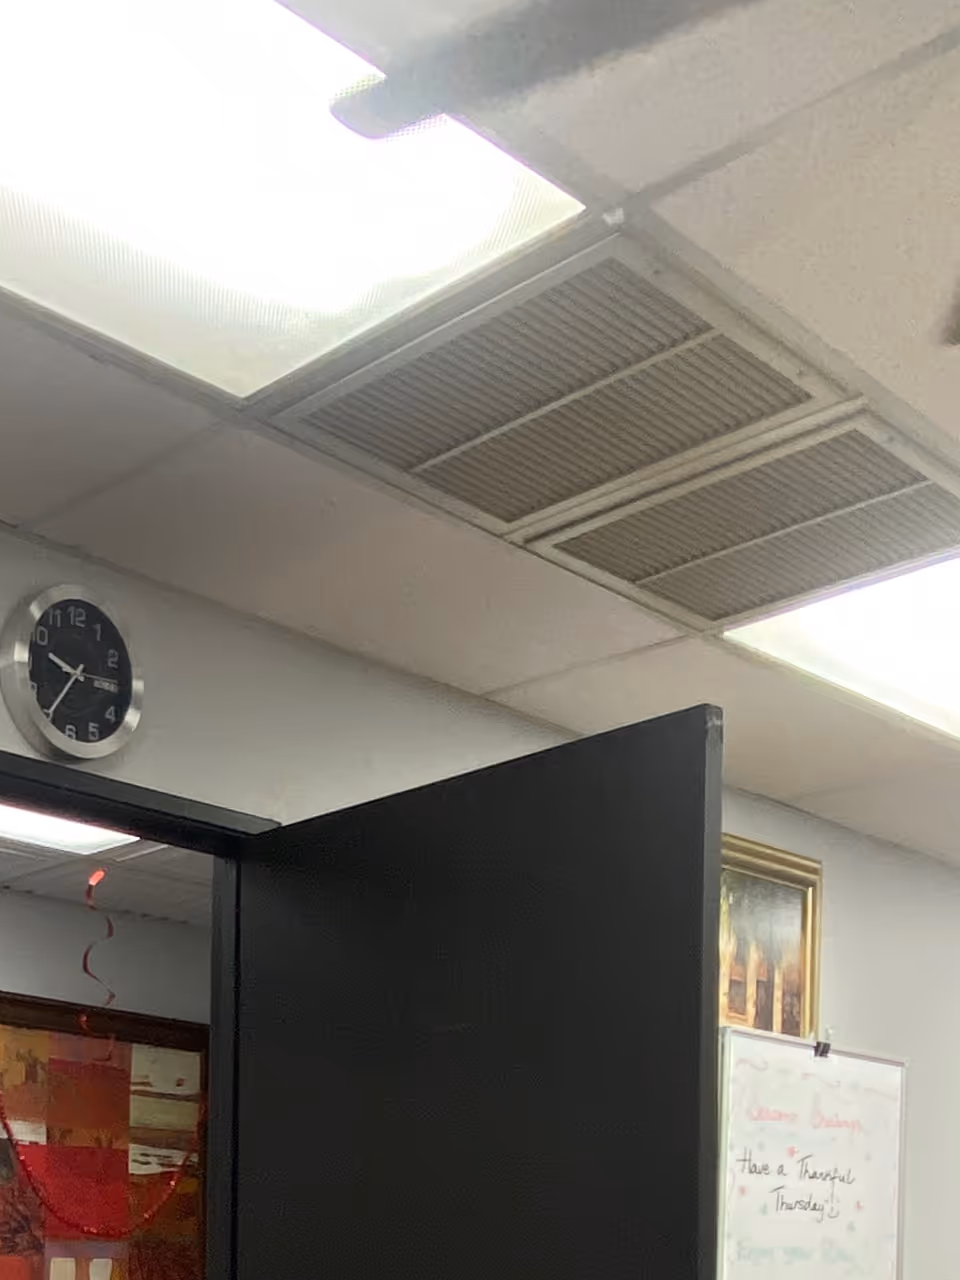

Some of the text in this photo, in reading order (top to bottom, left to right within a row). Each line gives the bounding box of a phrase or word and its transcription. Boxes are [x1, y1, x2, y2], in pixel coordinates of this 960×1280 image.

[48, 608, 62, 627] 11
[67, 606, 86, 627] 12
[94, 624, 102, 641] 1
[107, 649, 119, 669] 2
[105, 705, 116, 724] 4
[88, 722, 100, 741] 5
[736, 1147, 856, 1185] Have a Thankful
